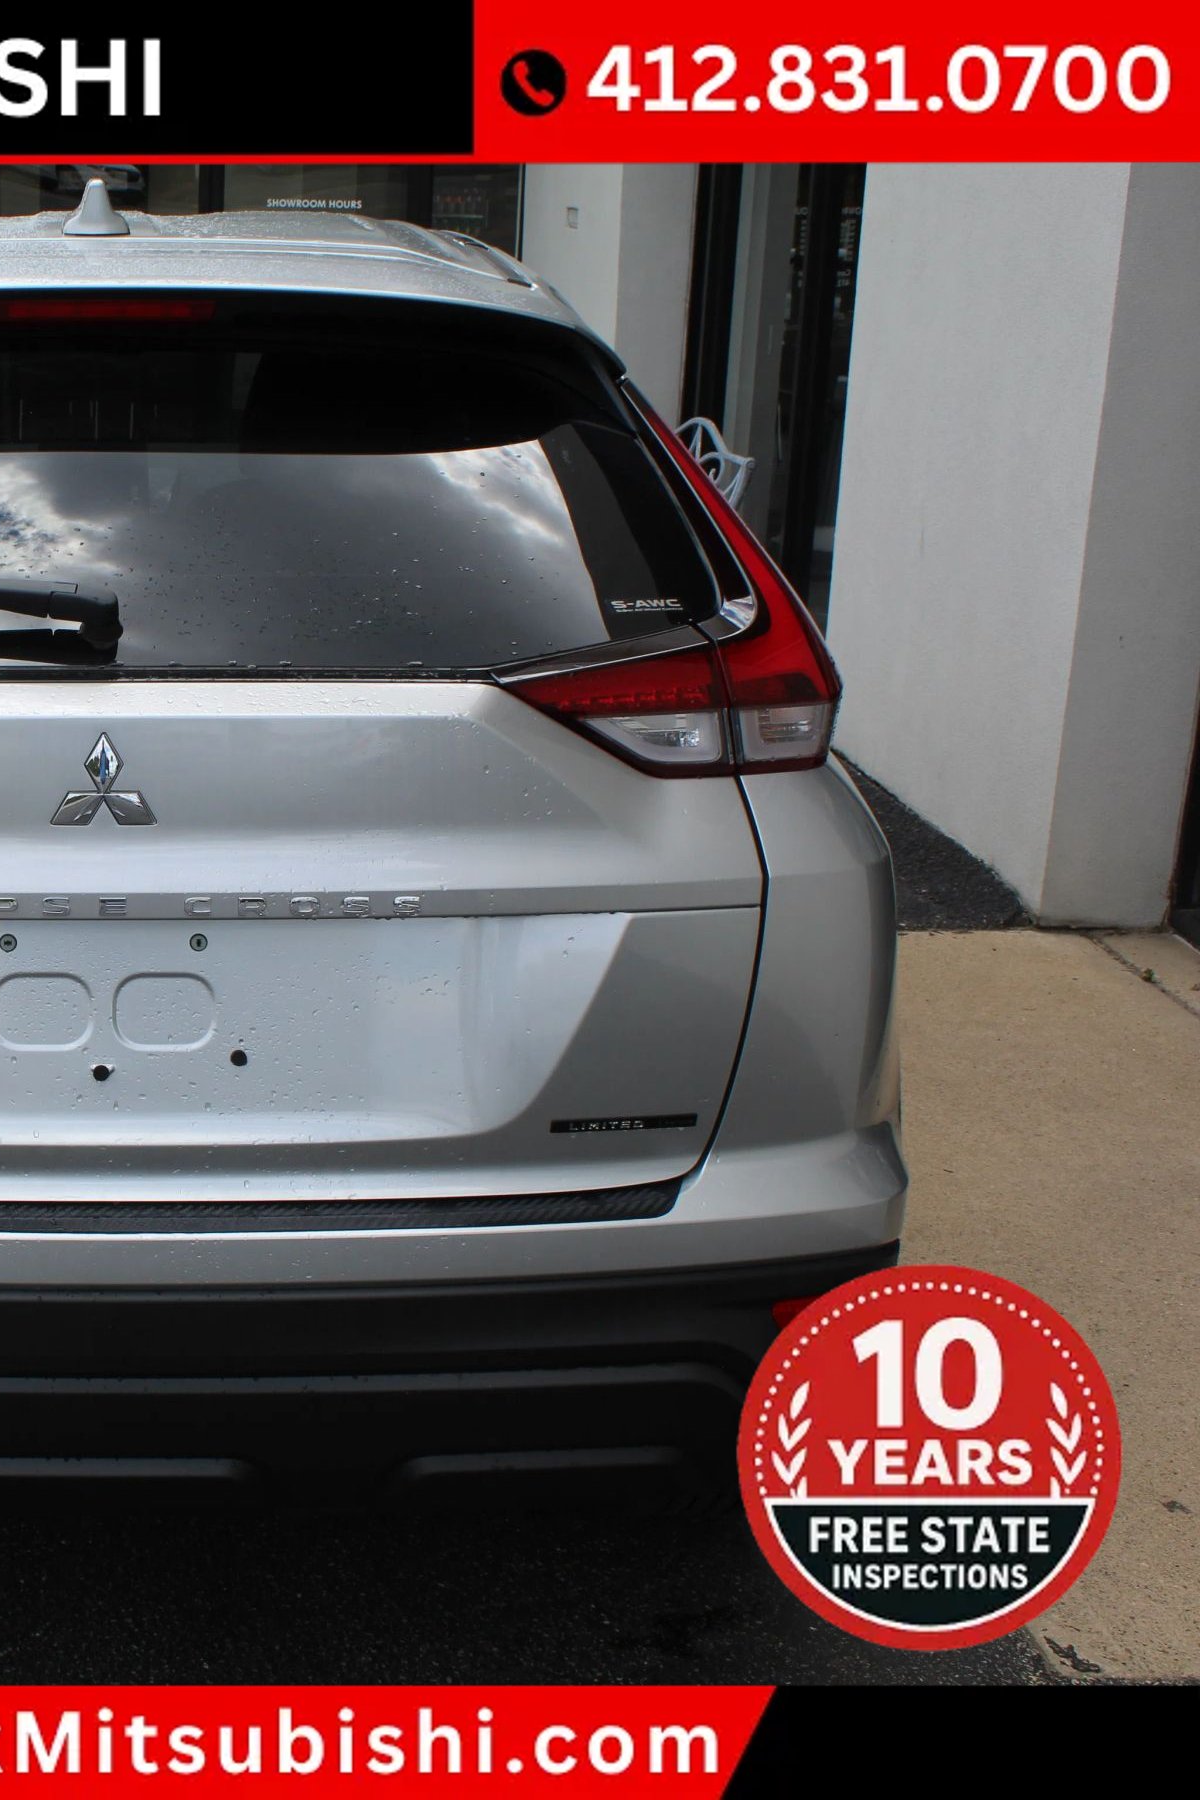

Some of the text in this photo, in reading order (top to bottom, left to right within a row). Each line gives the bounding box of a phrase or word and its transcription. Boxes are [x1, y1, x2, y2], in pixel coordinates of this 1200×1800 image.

[266, 198, 362, 209] SHOWROOM HOURS
[610, 598, 681, 609] S-AWC
[183, 894, 423, 917] CROSS
[568, 1119, 644, 1131] LIMITED
